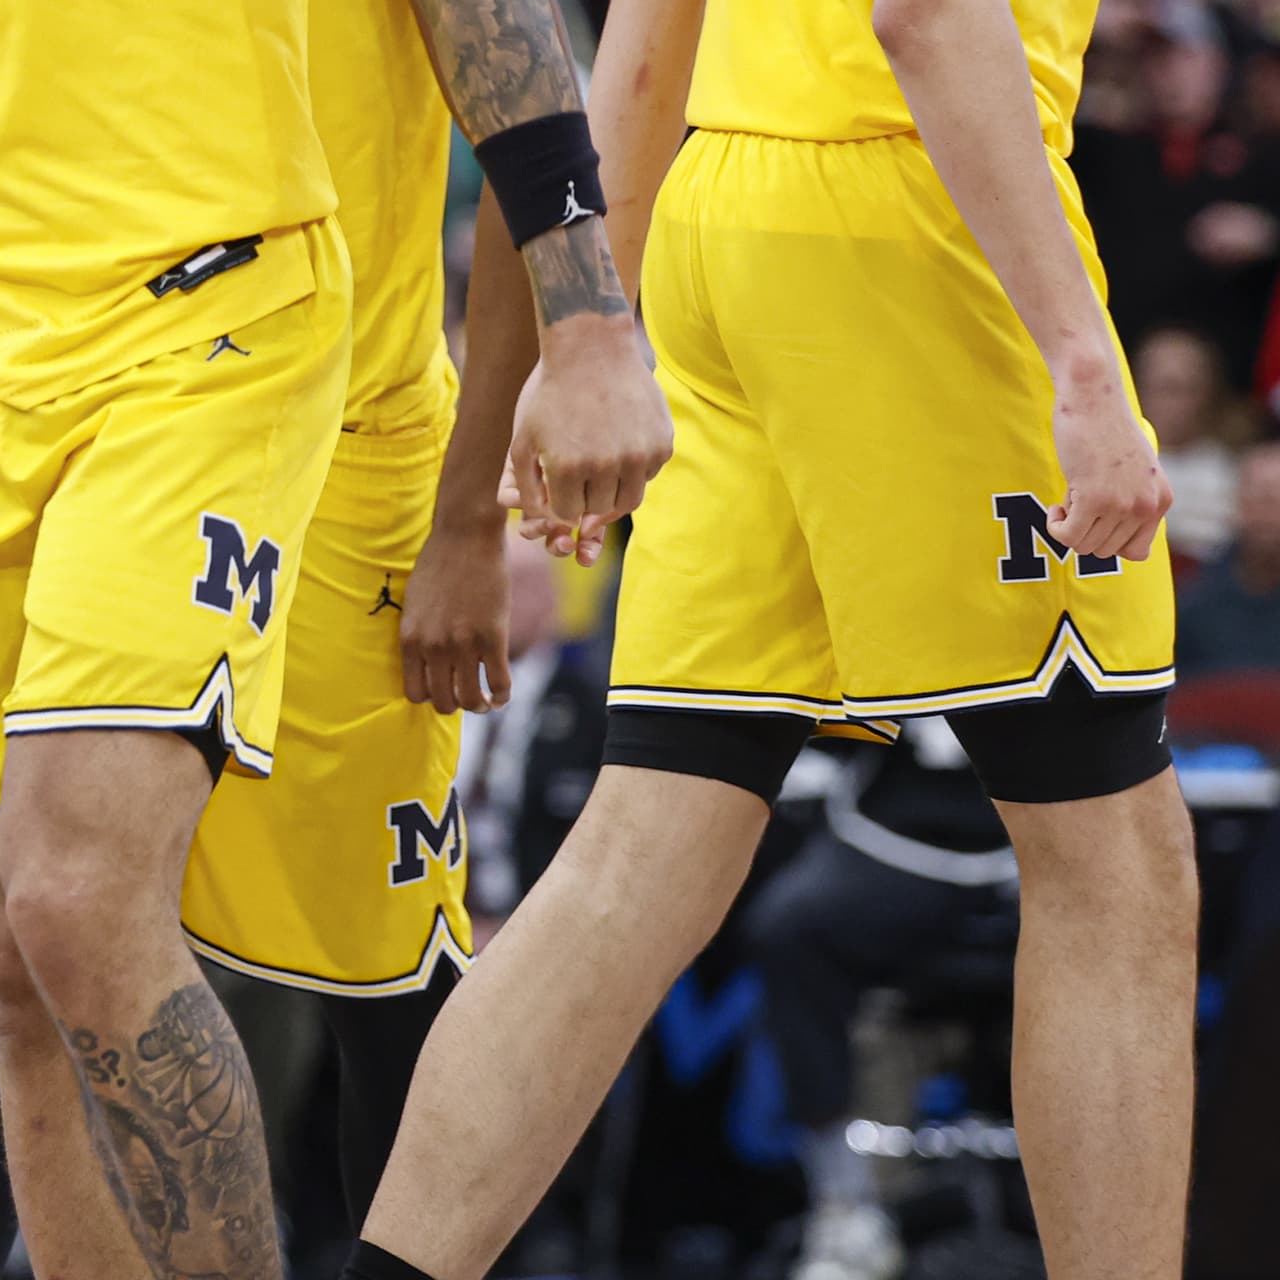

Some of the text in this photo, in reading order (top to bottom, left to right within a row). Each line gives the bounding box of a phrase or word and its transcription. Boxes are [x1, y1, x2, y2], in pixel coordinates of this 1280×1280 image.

[192, 511, 281, 637] M
[992, 491, 1123, 583] M
[387, 783, 464, 887] M
